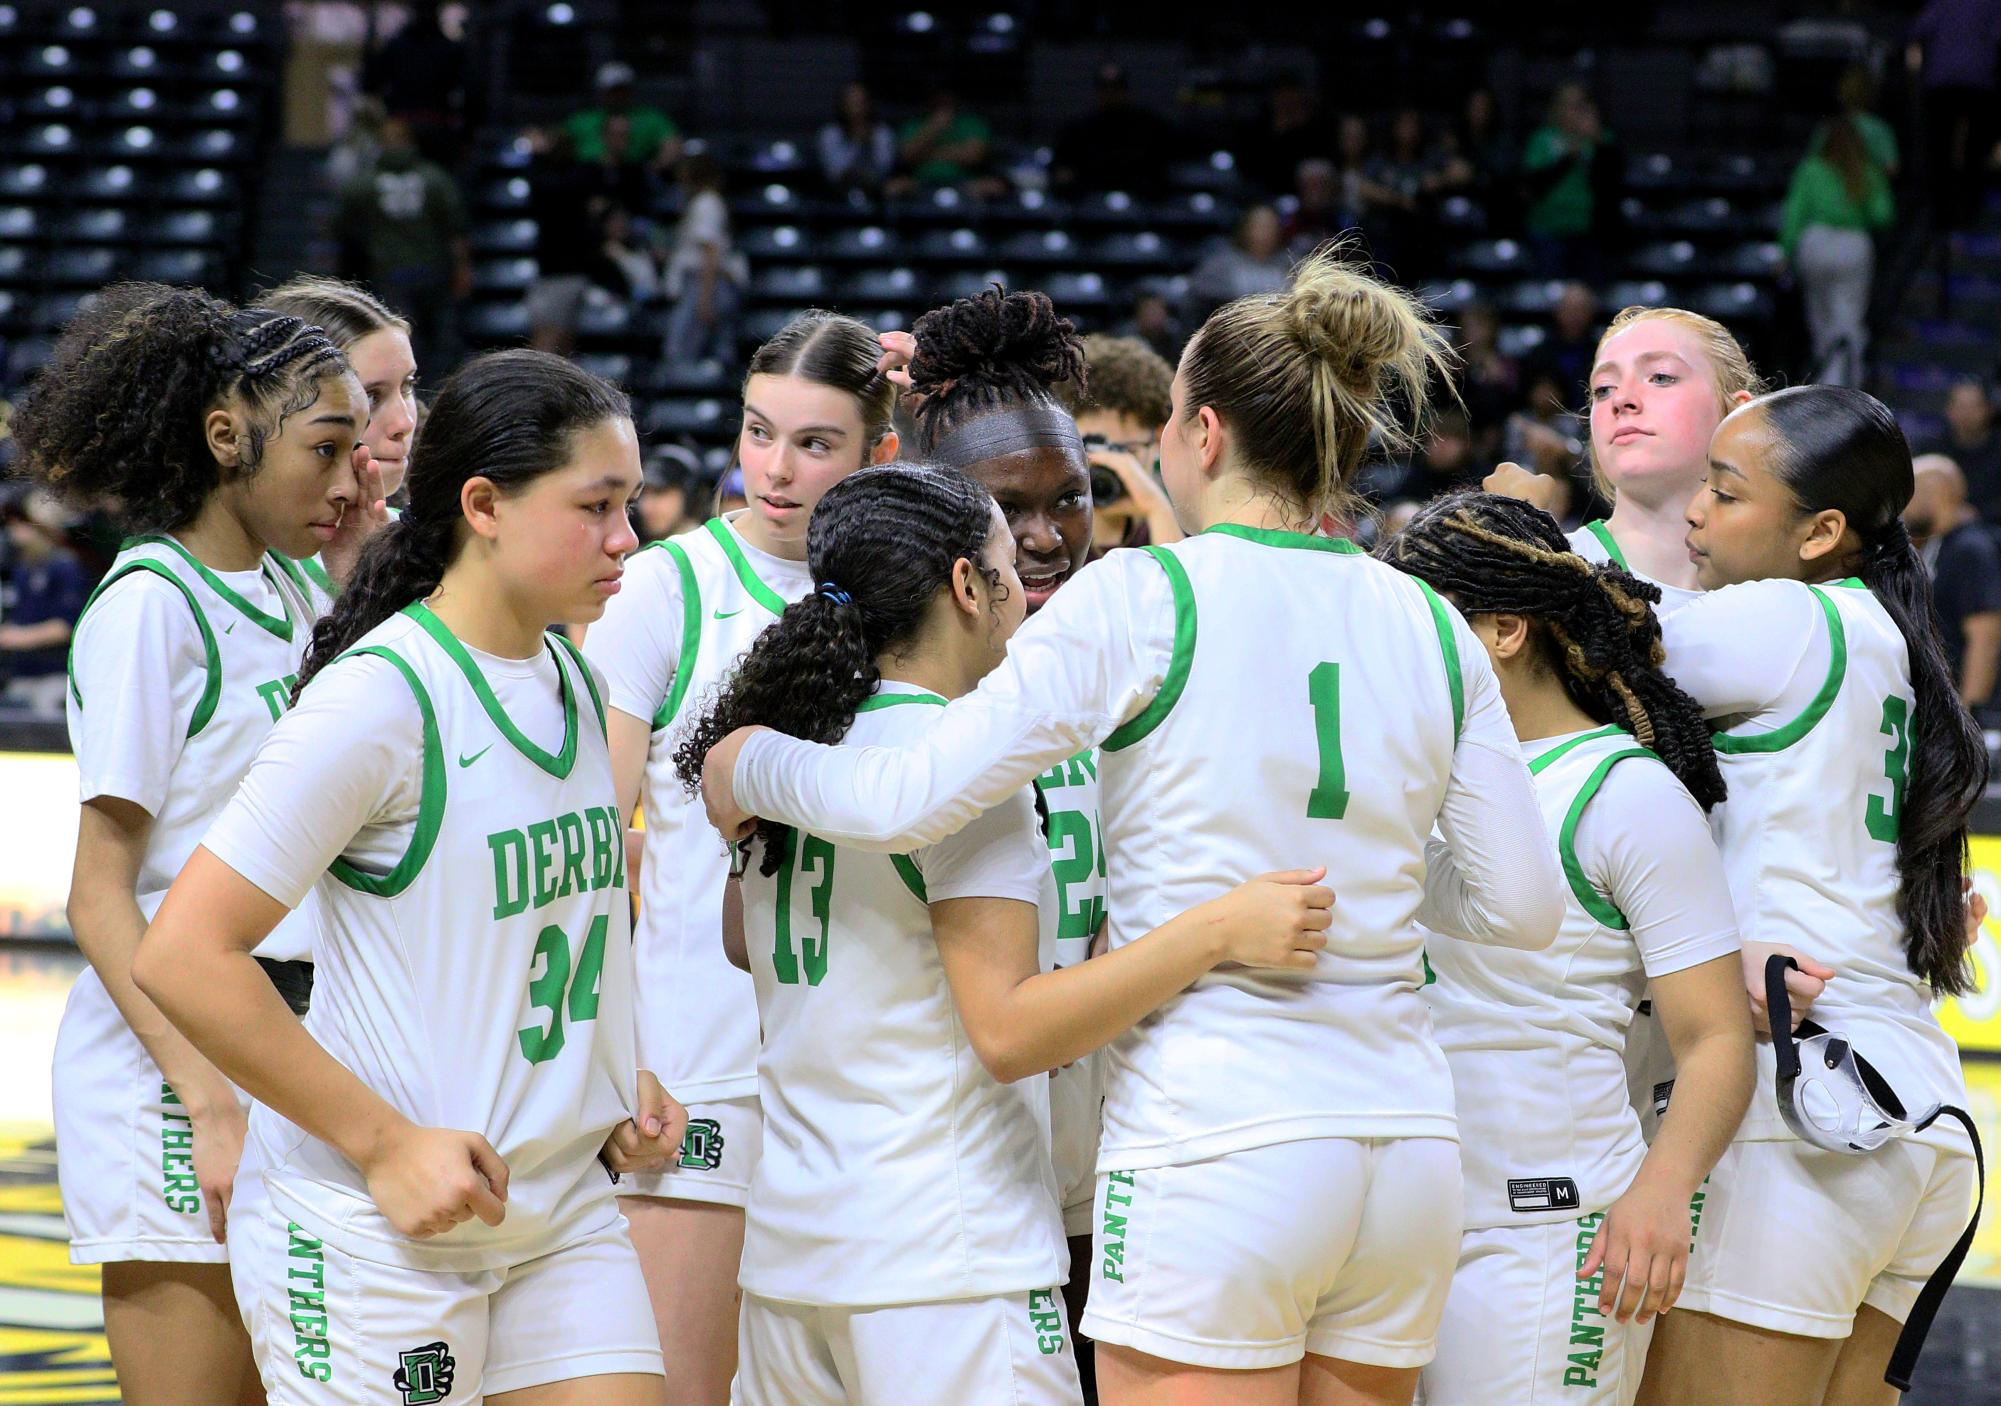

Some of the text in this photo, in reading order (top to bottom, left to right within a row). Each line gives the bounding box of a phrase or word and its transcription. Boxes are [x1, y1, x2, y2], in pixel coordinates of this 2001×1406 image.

[1306, 661, 1350, 819] 1
[1865, 694, 1918, 844] 3
[772, 826, 835, 987] 13
[1049, 810, 1108, 939] 2
[517, 914, 609, 1067] 34
[1556, 1187, 1569, 1200] M
[288, 1221, 332, 1383] NTHERS
